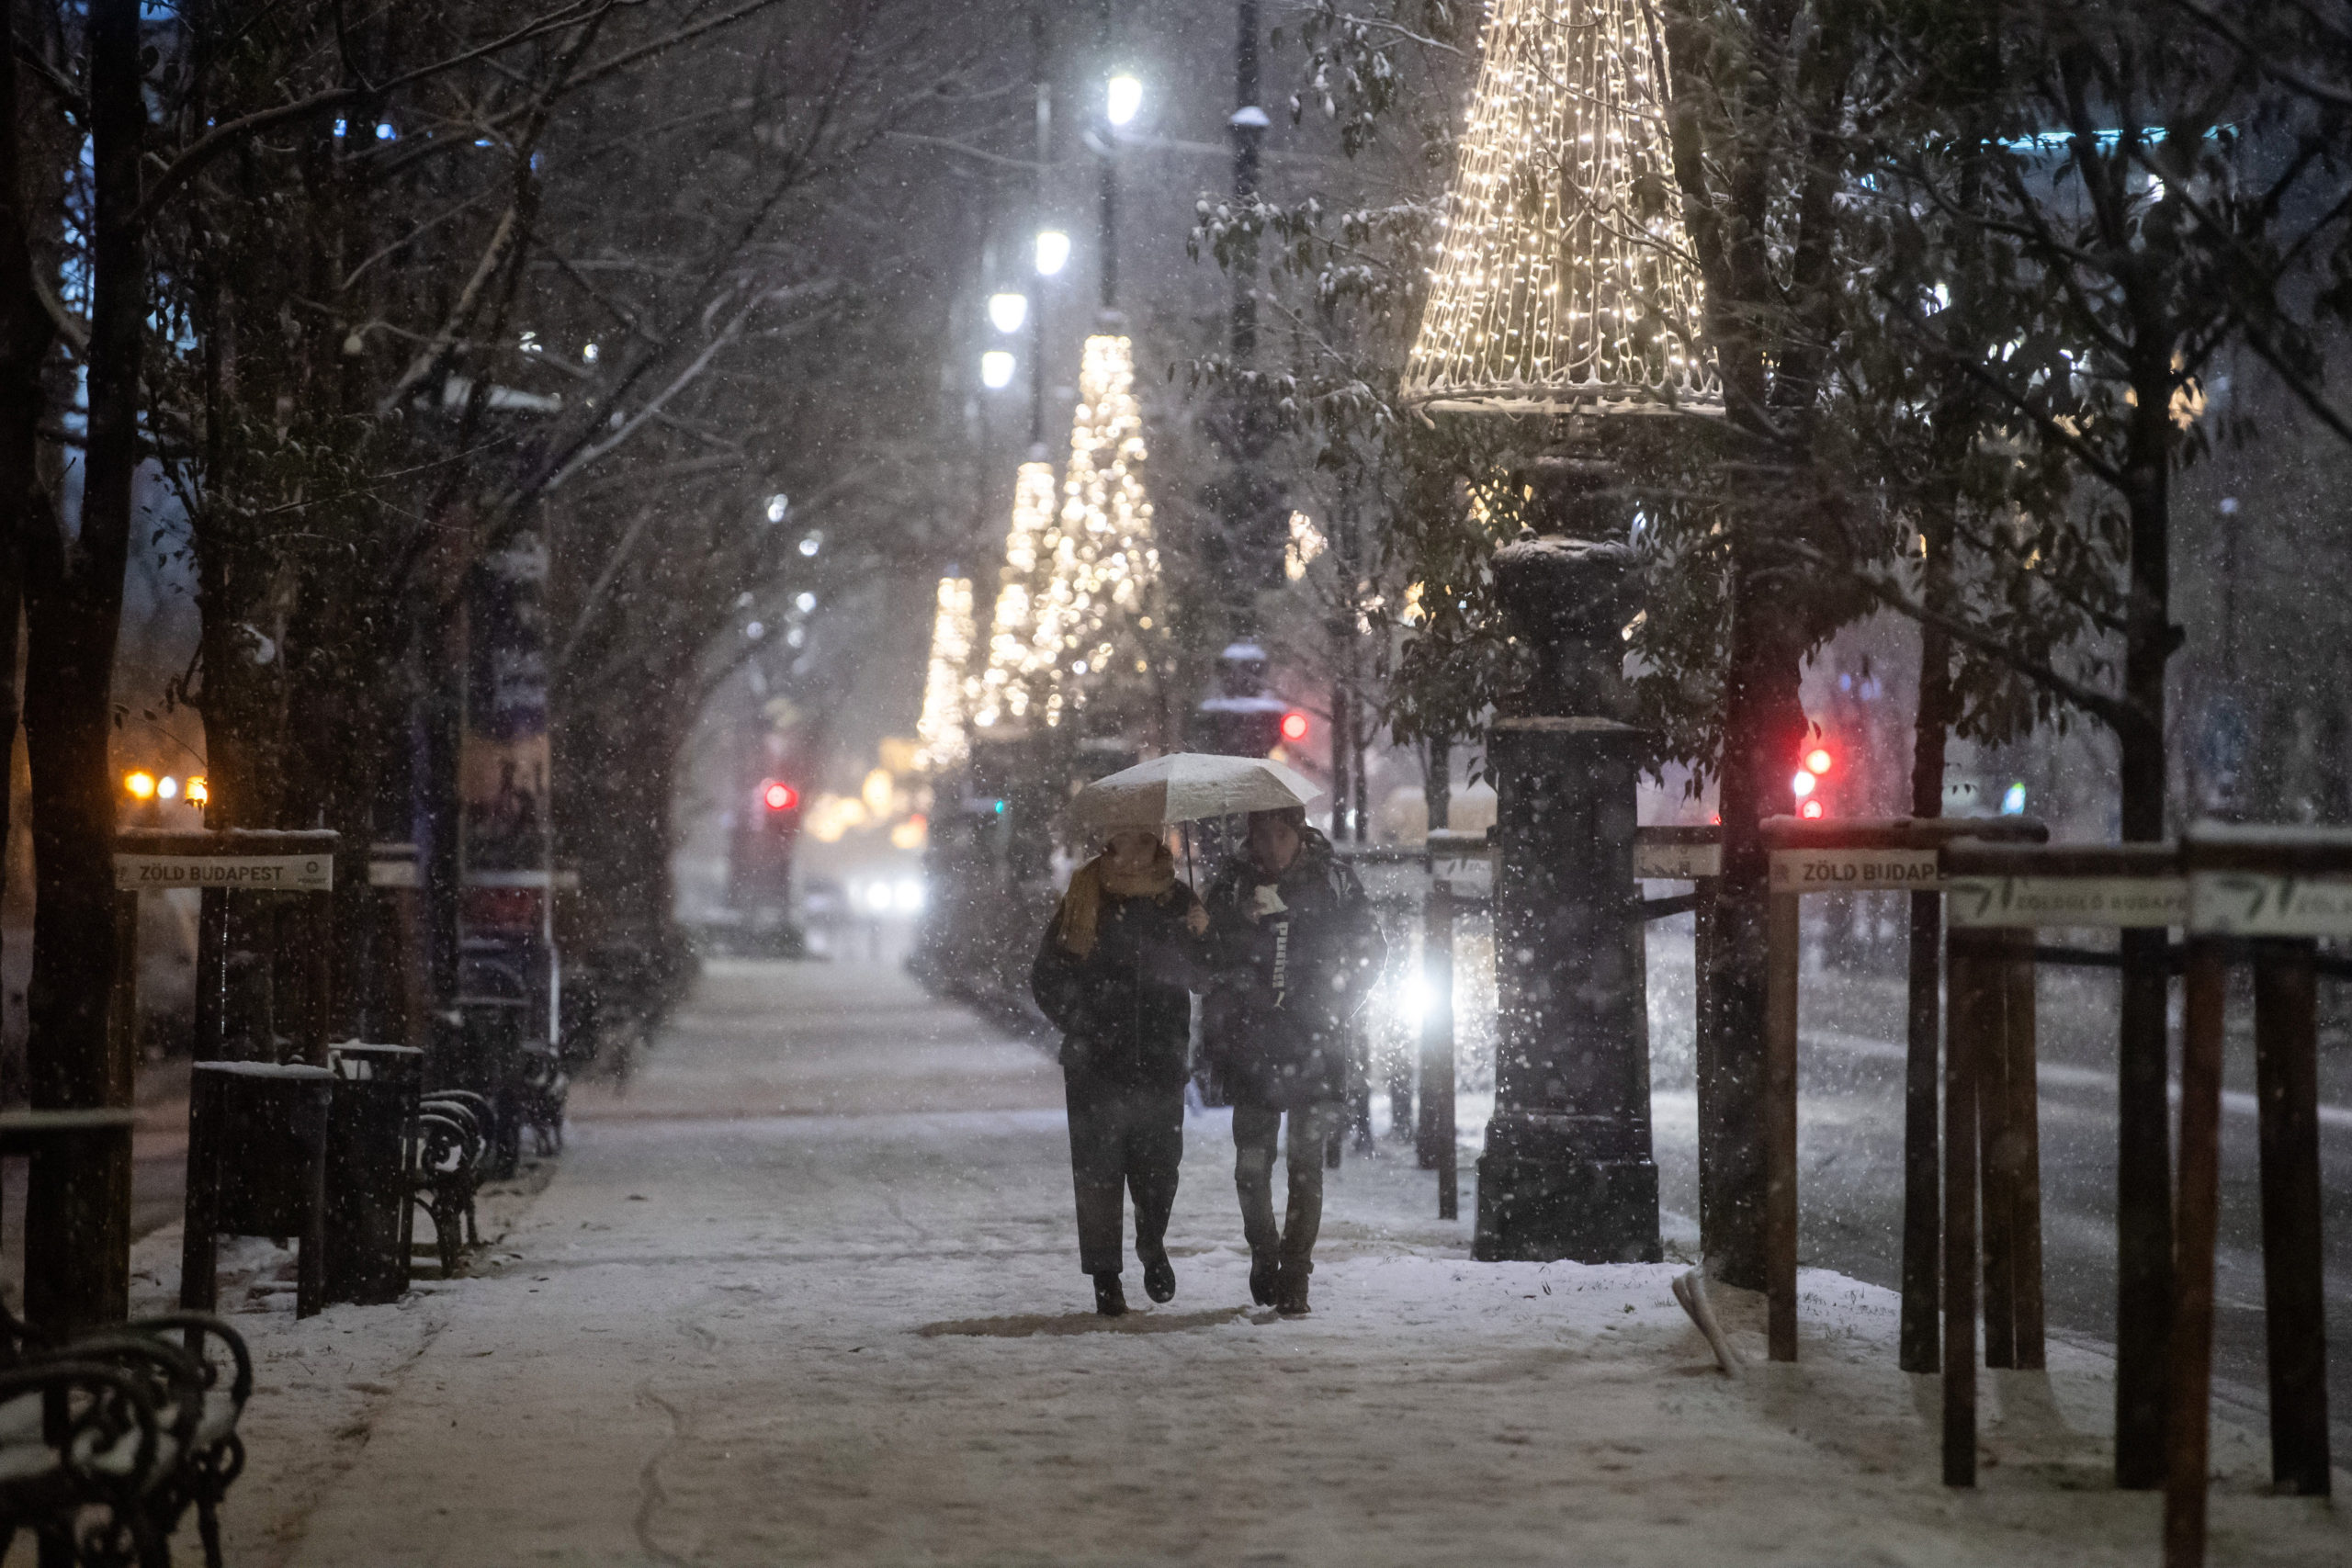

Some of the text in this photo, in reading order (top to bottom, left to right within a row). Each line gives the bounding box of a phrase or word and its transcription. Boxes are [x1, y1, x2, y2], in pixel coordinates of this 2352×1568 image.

[140, 863, 184, 881] ZÖLD
[189, 865, 283, 881] BUDAPEST
[1804, 860, 1856, 881] ZÖLD
